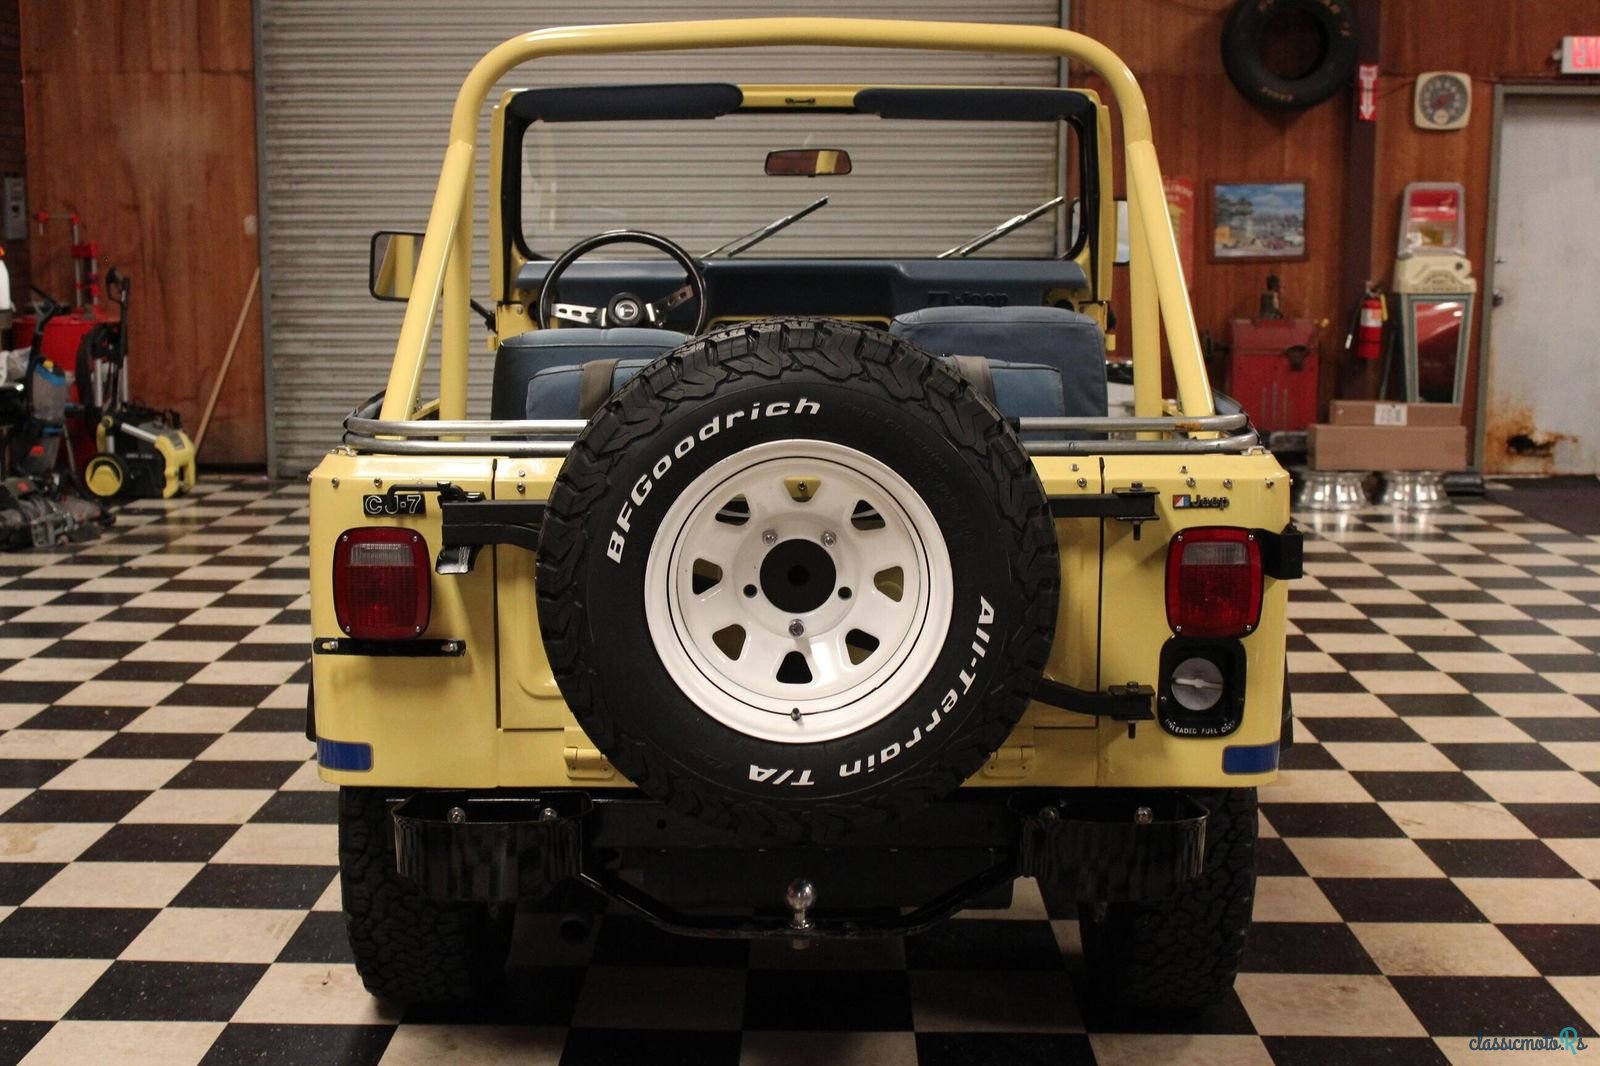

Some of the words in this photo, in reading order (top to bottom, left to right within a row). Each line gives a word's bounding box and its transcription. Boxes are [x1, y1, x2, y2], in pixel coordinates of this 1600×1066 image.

[606, 397, 821, 564] BFGoodrich
[1190, 494, 1230, 511] Jeep
[839, 595, 995, 777] All-Terrain
[749, 764, 815, 786] T/A
